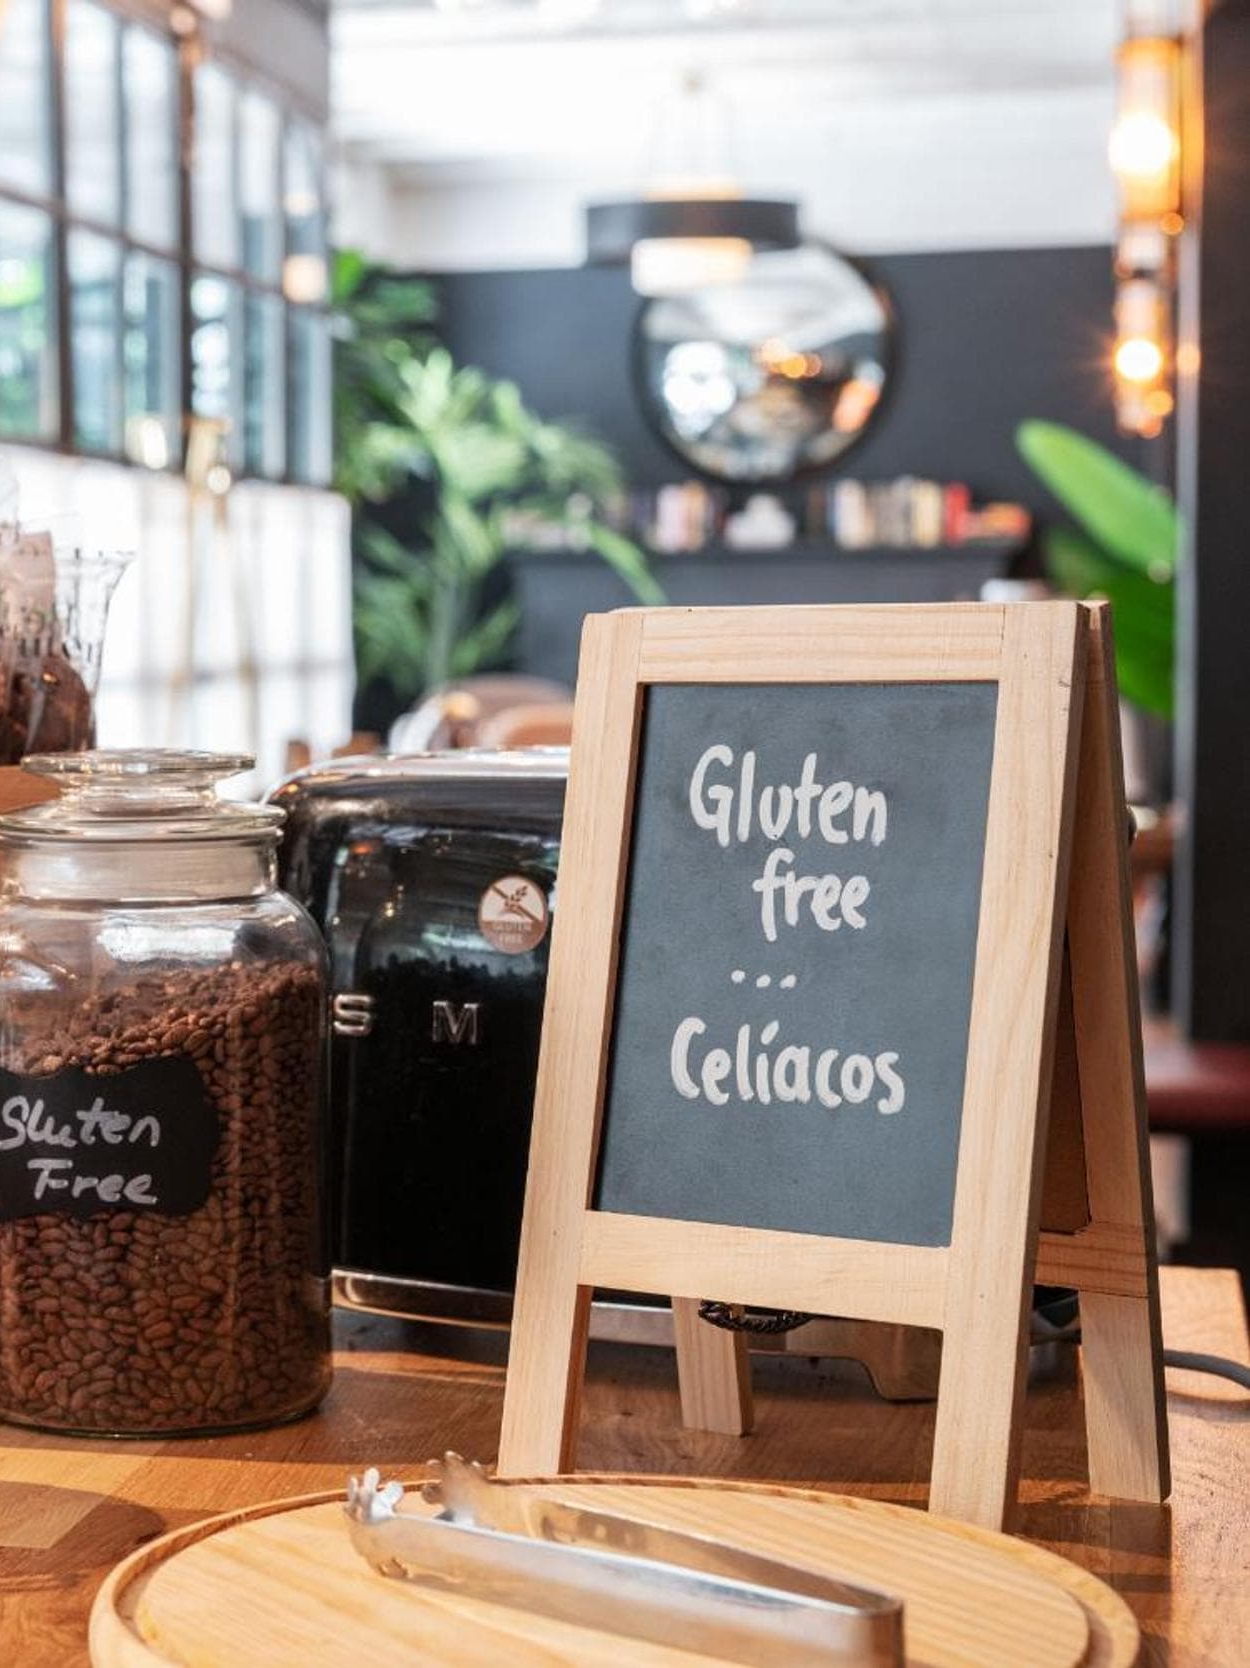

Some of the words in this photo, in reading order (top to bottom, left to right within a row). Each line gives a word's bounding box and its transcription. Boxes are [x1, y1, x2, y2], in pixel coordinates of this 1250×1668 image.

[689, 744, 888, 847] Gluten
[753, 848, 871, 942] free
[669, 1016, 906, 1115] Celíacos
[27, 1158, 158, 1205] Free
